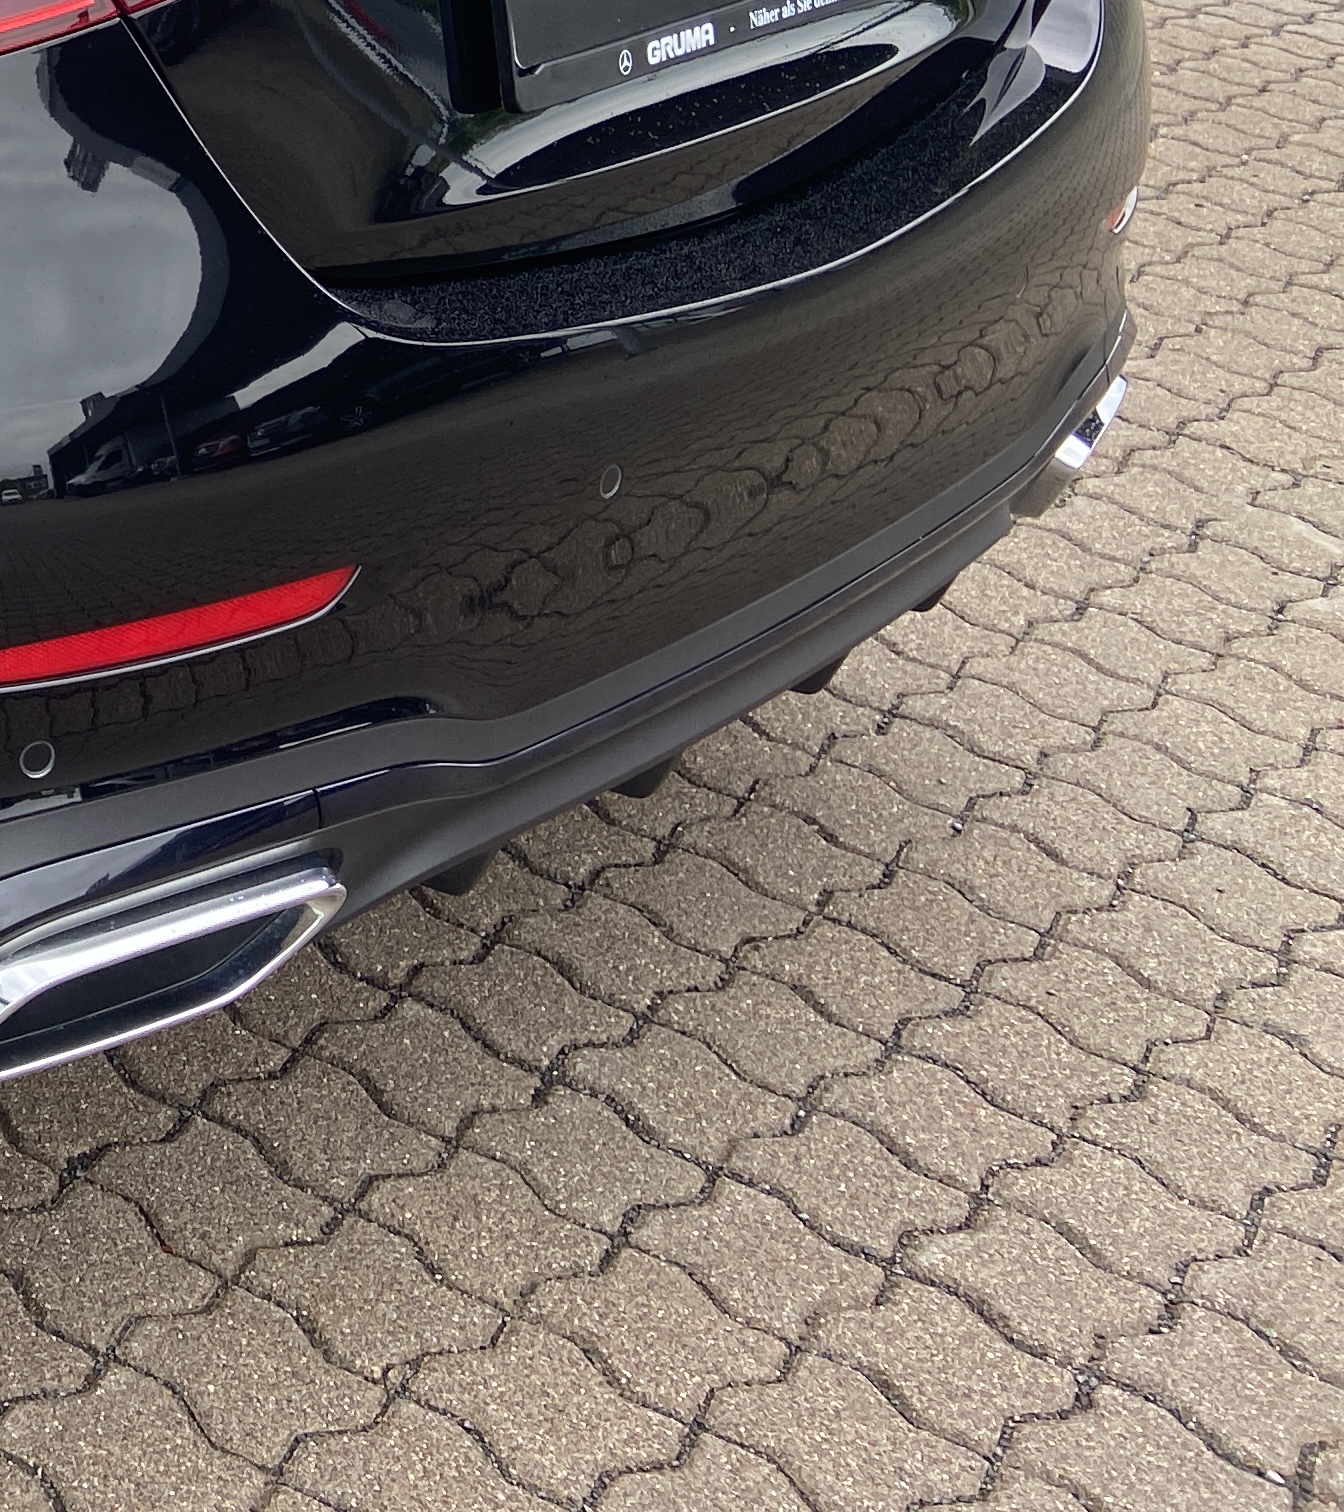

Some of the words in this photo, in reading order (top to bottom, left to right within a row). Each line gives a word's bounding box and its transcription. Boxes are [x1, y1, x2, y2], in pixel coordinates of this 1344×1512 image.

[748, 7, 780, 30] Näher
[782, 0, 796, 20] als
[646, 22, 715, 65] GRUMA
